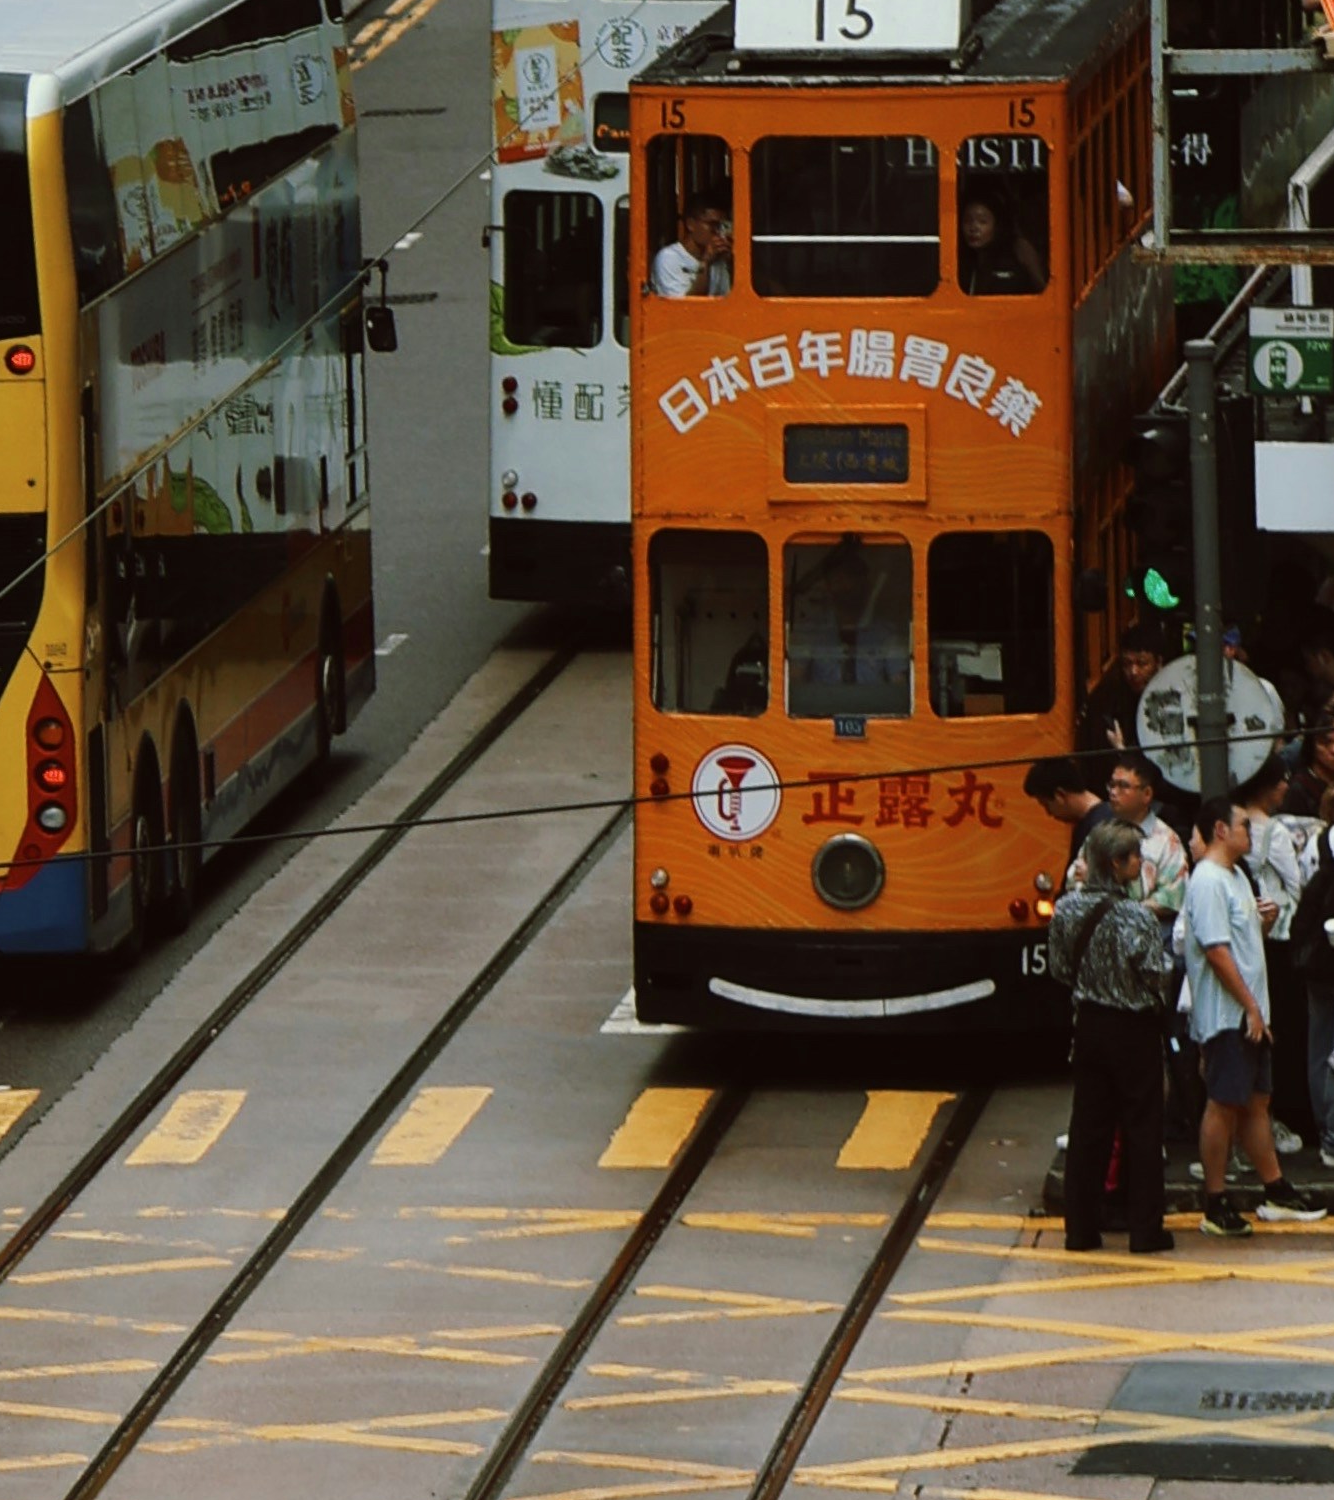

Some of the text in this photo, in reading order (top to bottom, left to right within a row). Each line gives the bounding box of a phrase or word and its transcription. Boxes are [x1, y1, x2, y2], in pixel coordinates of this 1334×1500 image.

[660, 99, 1037, 129] 15 15
[658, 327, 1044, 438] 日本百年腸胃良藥
[802, 770, 1004, 830] 正露丸
